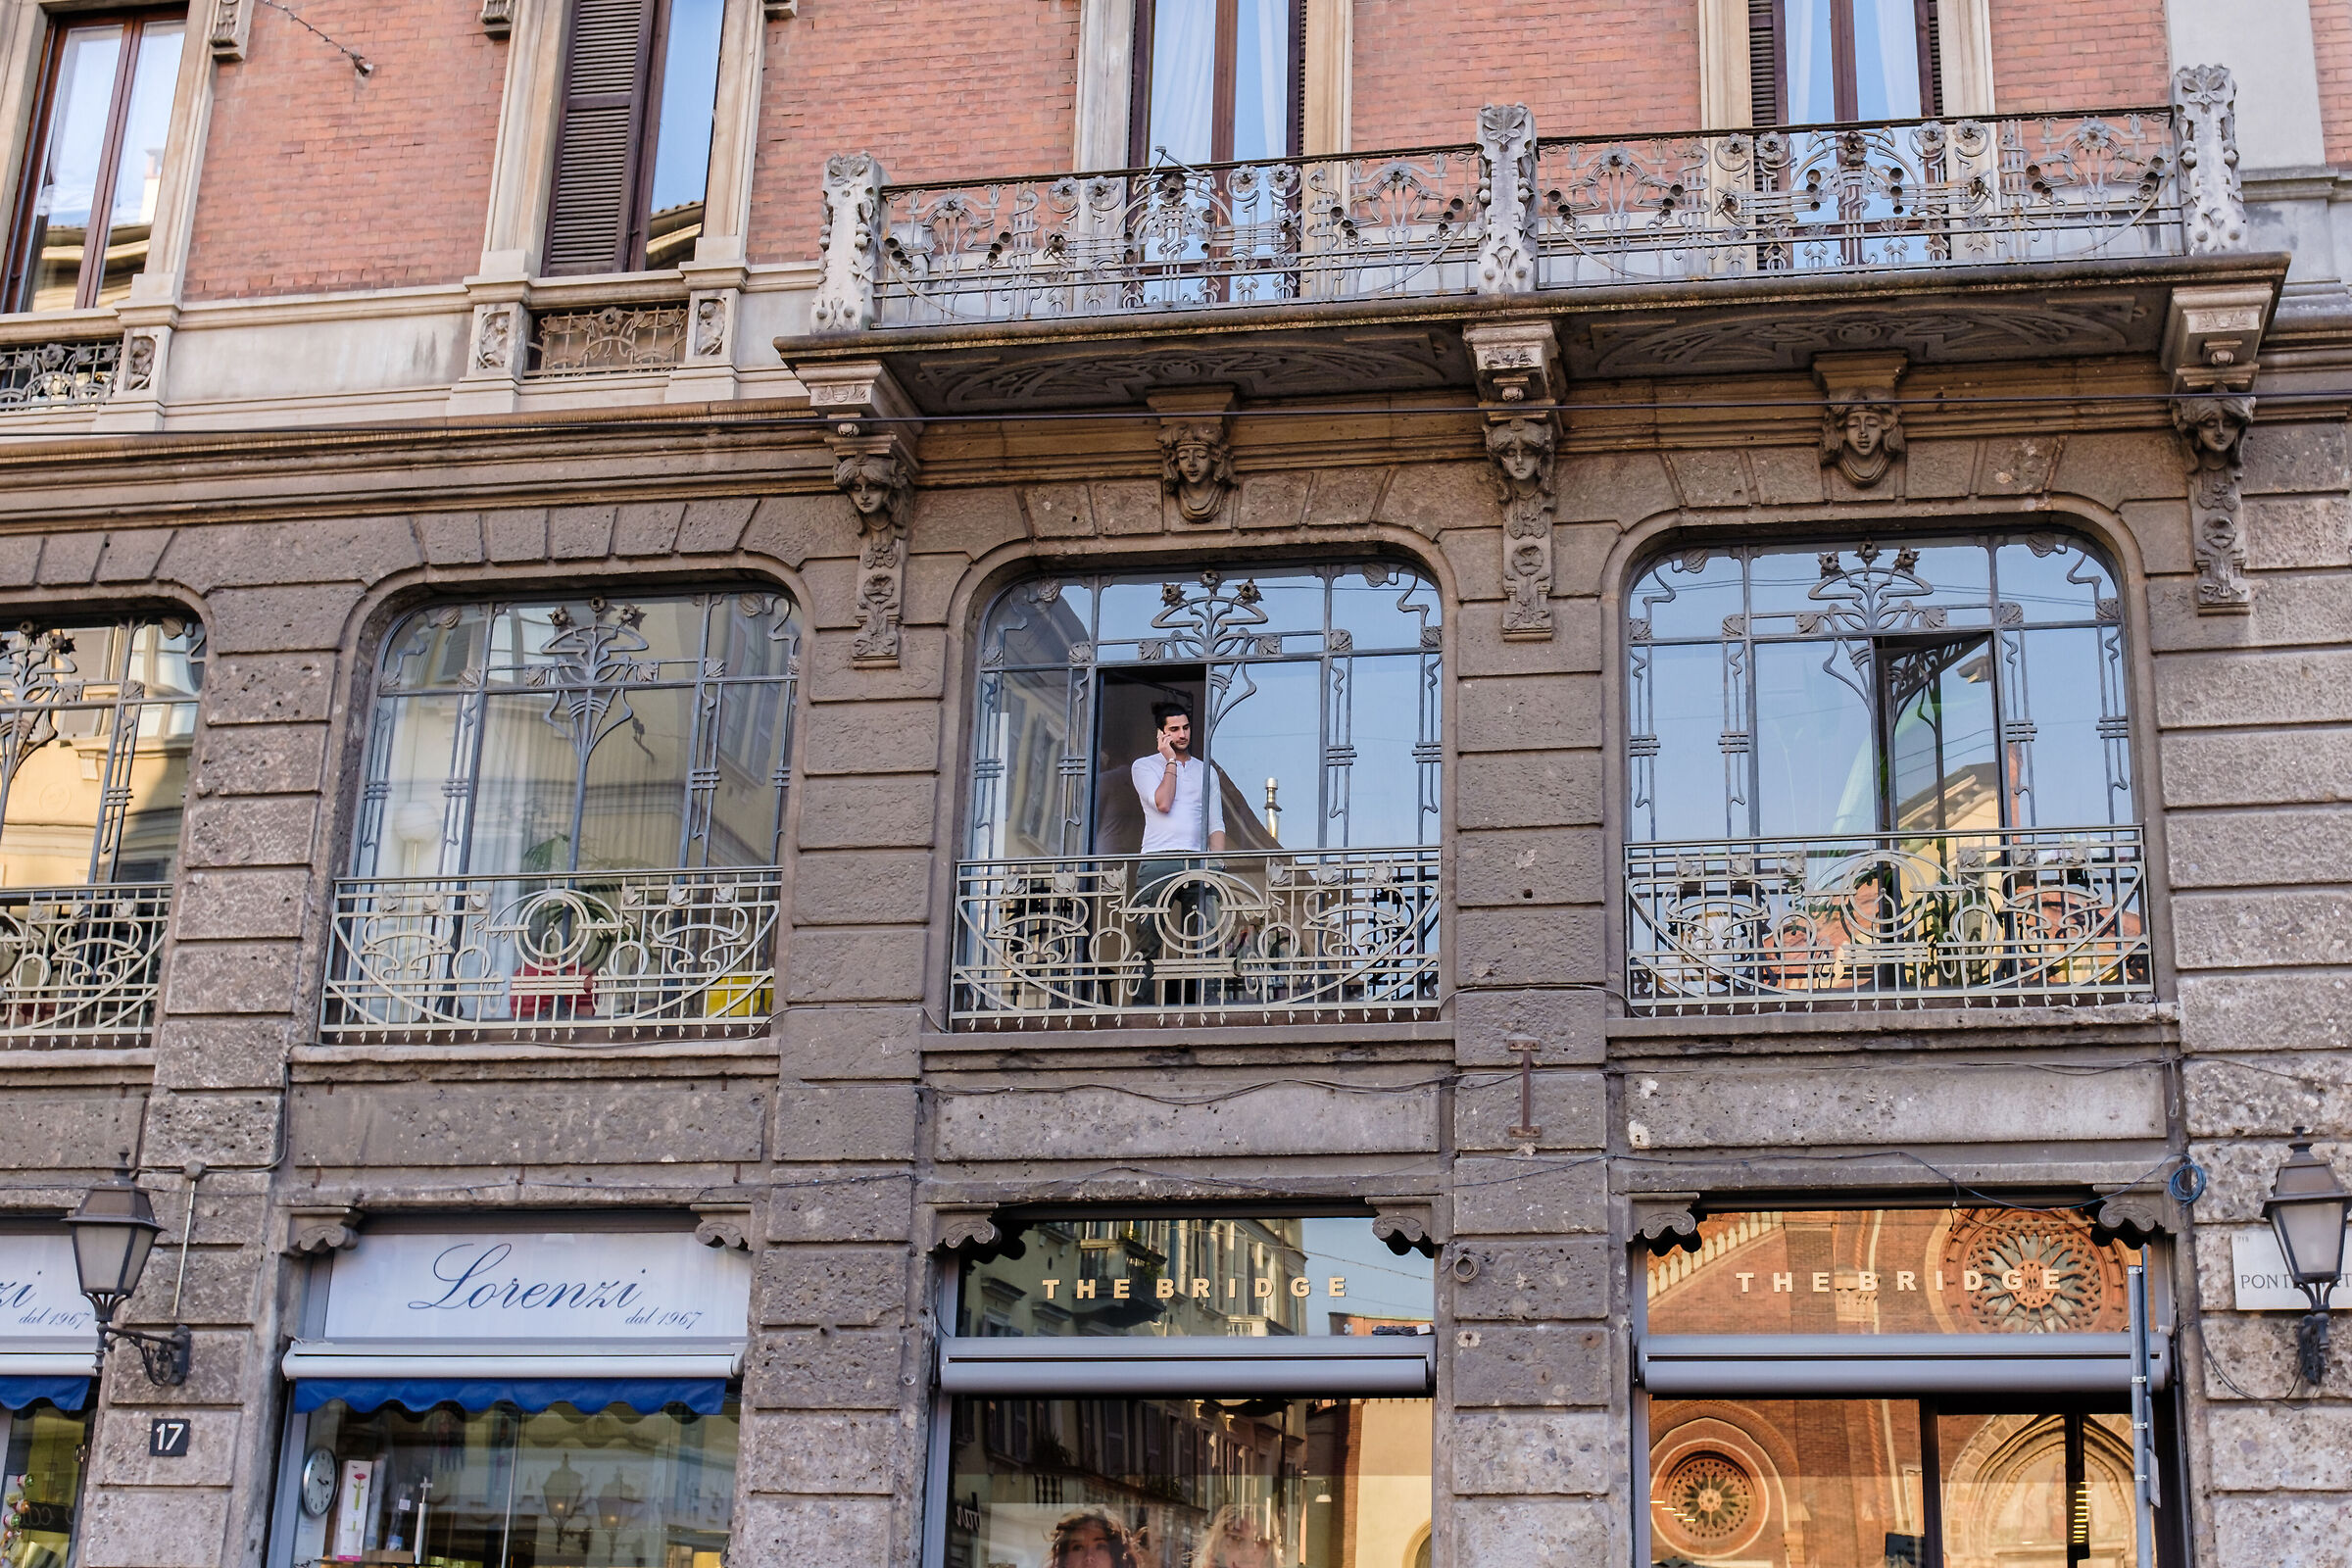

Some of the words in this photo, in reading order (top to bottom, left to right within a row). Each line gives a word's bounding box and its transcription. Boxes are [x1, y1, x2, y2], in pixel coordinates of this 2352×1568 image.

[408, 1243, 646, 1309] Lorenzi
[1043, 1278, 1131, 1299] THE
[1156, 1276, 1347, 1299] BRIDGE
[1736, 1272, 1831, 1293] THE
[1858, 1269, 2060, 1292] BRIDGE
[19, 1307, 51, 1324] dal
[48, 1311, 90, 1330] 1967
[624, 1307, 660, 1325] dal
[658, 1311, 705, 1330] 1967
[157, 1423, 184, 1450] 17
